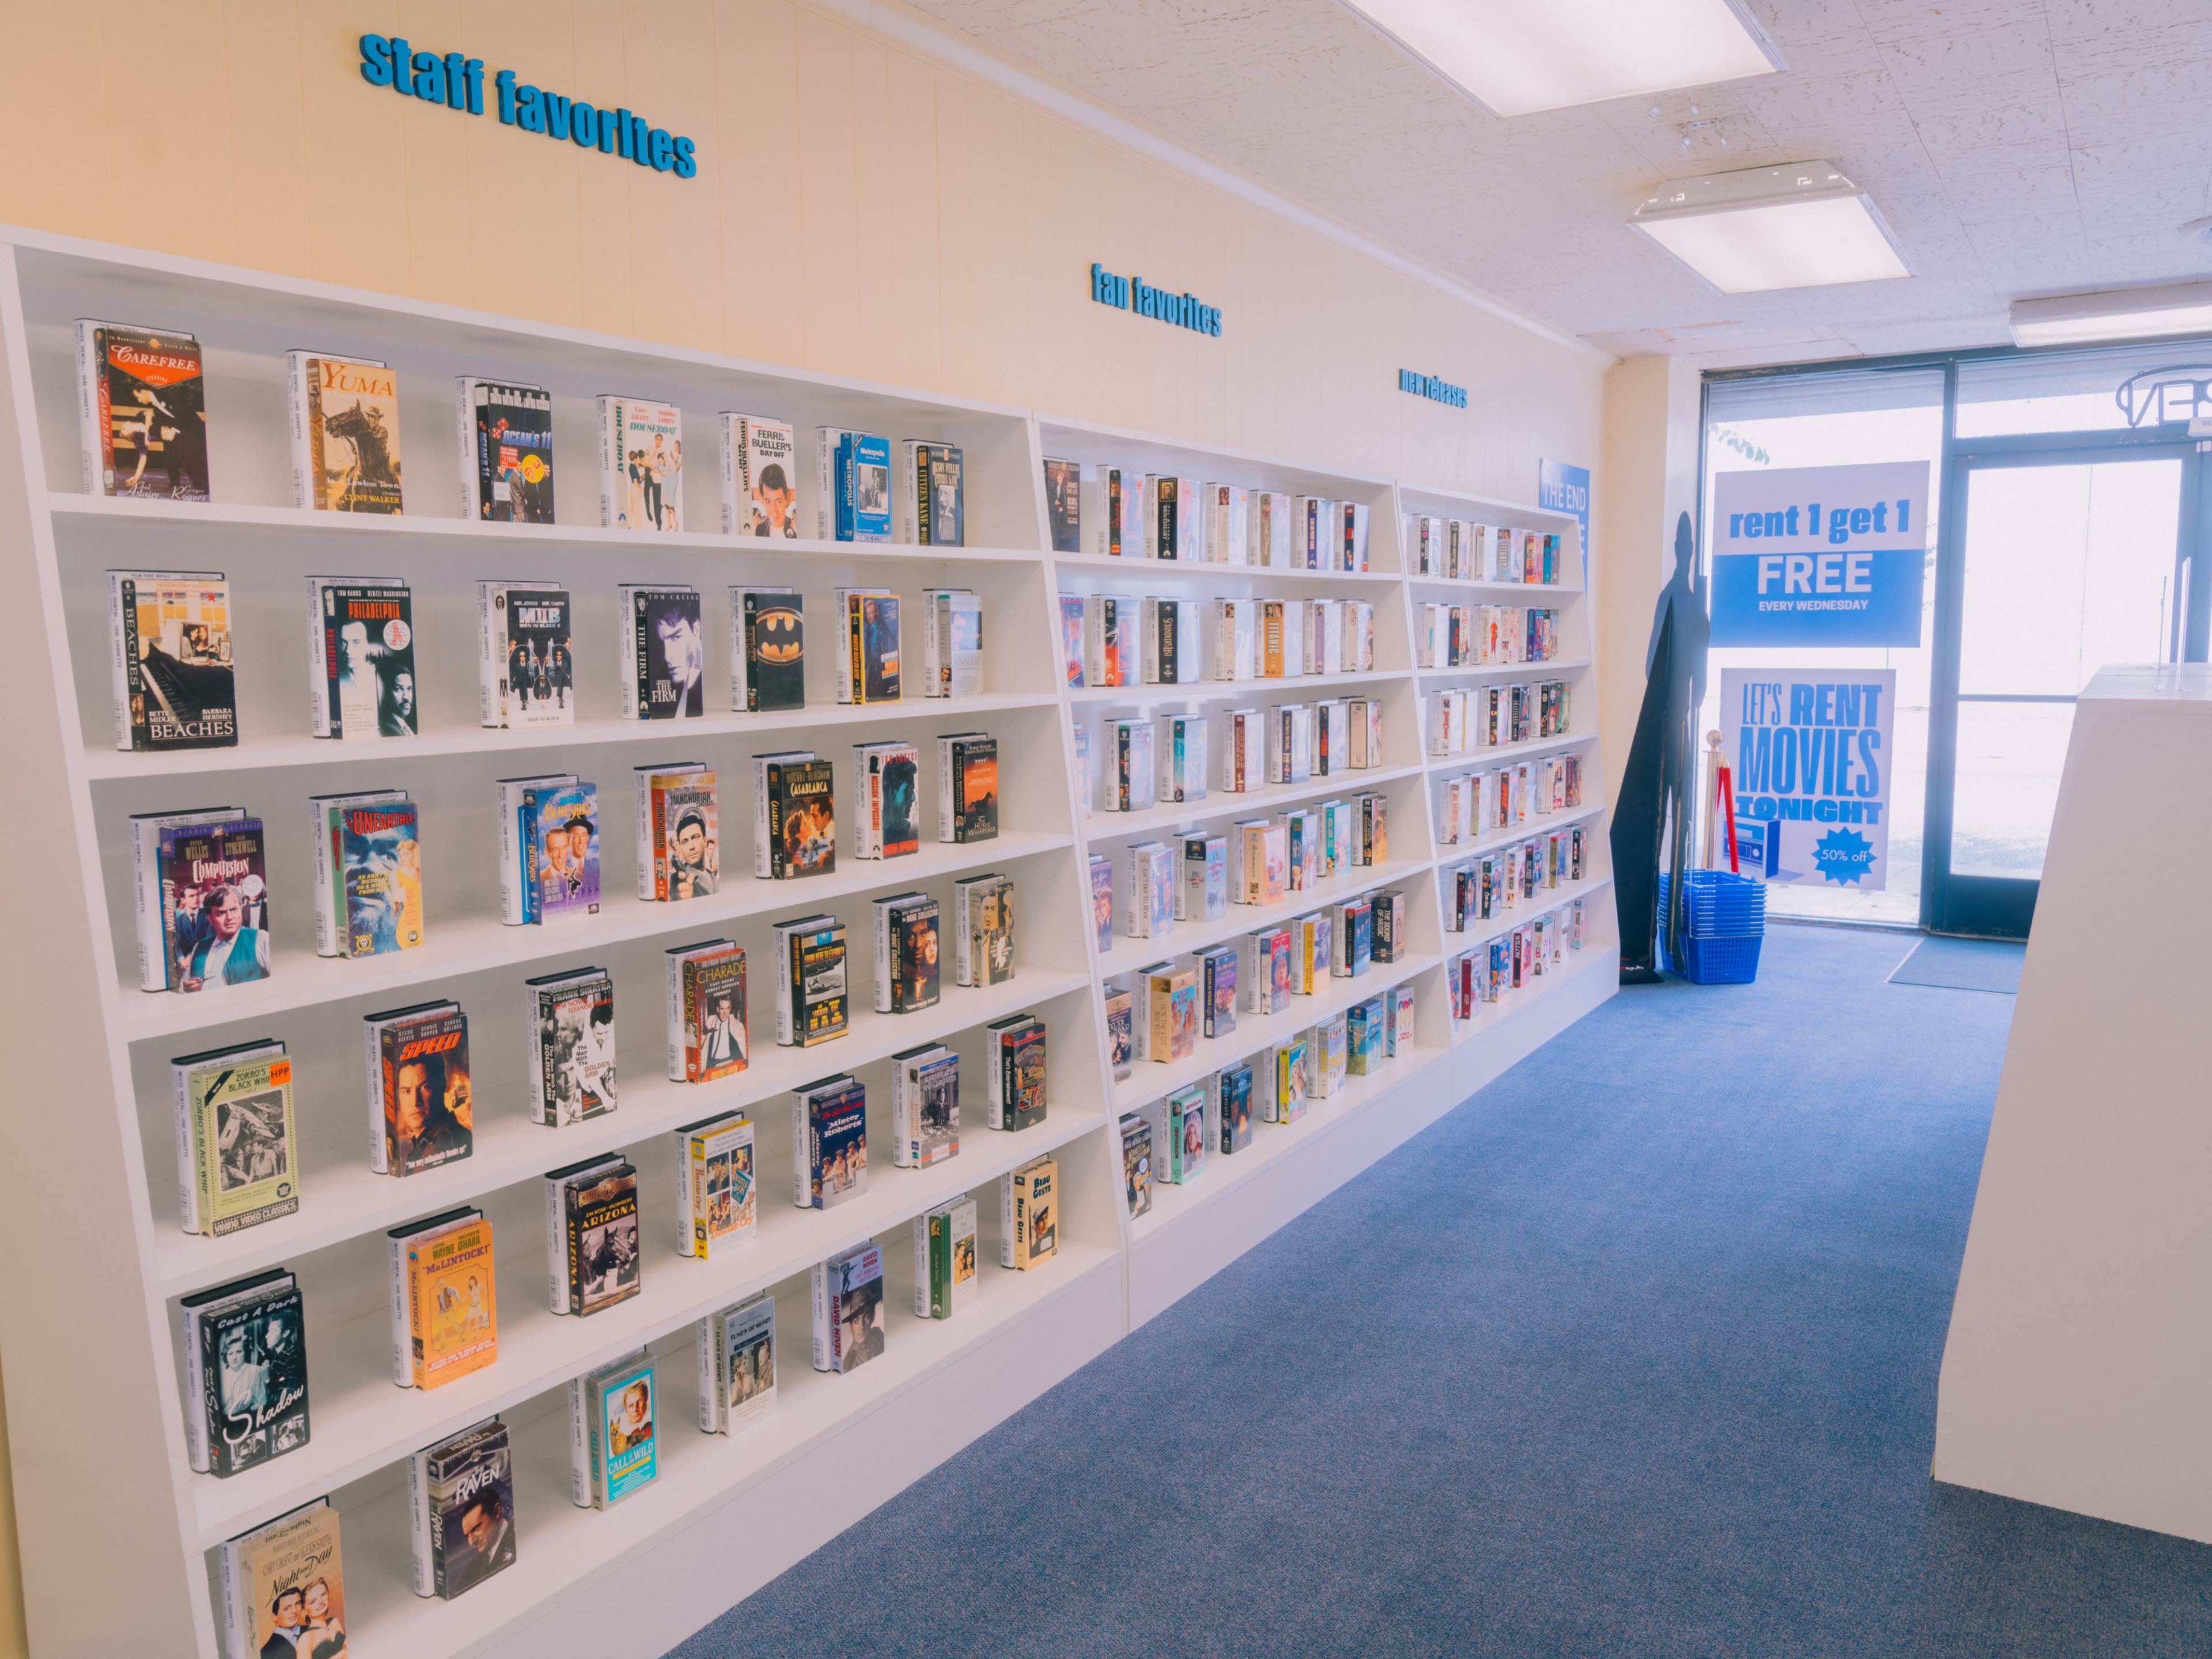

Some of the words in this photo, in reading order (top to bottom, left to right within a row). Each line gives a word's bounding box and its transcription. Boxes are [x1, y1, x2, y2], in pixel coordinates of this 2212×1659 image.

[359, 33, 484, 115] staff
[495, 70, 696, 179] favorites
[1090, 263, 1129, 310] fan
[1131, 276, 1222, 338] favorites
[111, 345, 196, 371] CAREFREE
[321, 362, 392, 396] YUMA
[1399, 369, 1423, 395] new
[1423, 376, 1468, 408] releases
[99, 382, 110, 452] CAREFREE
[630, 422, 677, 434] HOUSEBOAT
[311, 416, 323, 475] YUMA
[502, 430, 540, 448] OCEAN'S
[541, 431, 551, 449] 11
[752, 439, 792, 452] BUELLER'S
[758, 430, 785, 441] FERRIS
[774, 450, 784, 459] OFF
[123, 483, 160, 498] Astaire
[171, 486, 206, 502] Rogers
[369, 495, 399, 503] WALKER
[1543, 481, 1563, 507] THE
[1566, 484, 1586, 512] END
[1730, 505, 1799, 539] rent
[1808, 503, 1821, 535] 1
[1828, 501, 1888, 544] get
[1896, 499, 1910, 532] 1
[1758, 553, 1873, 594] FREE
[349, 602, 400, 619] PHILADELPHIA
[1759, 601, 1794, 611] EVERY
[1796, 600, 1869, 611] WEDNESDAY
[126, 608, 138, 685] BEACHES
[1268, 622, 1280, 654] TITANIC
[325, 628, 338, 679] PHILADELPHIA
[639, 651, 647, 680] FIRM
[652, 690, 677, 702] FIRM
[656, 682, 671, 691] THE
[1743, 683, 1782, 725] LET'S
[1790, 684, 1883, 727] RENT
[151, 722, 234, 739] BEACHES
[1738, 726, 1881, 798] MOVIES
[671, 792, 711, 805] MANCHURIAN
[790, 782, 828, 796] CASABLANCA
[771, 801, 779, 835] CASABLANCA
[1735, 796, 1883, 824] TONIGHT
[353, 811, 415, 836] UNEARTHLY
[1821, 850, 1848, 861] 50%
[1851, 851, 1868, 862] off
[192, 857, 249, 883] COMPULSION
[697, 960, 746, 984] CHARADE
[553, 989, 579, 1002] FRANK
[579, 983, 612, 997] SINATRA
[684, 964, 695, 1022] CHARADE
[400, 1032, 461, 1060] SPEED
[236, 1069, 266, 1082] ZORRO'S
[271, 1067, 290, 1079] HPP
[584, 1060, 610, 1073] GOLDEN
[585, 1070, 599, 1079] ARM
[228, 1080, 252, 1092] BLACK
[383, 1056, 396, 1124] SPEED
[195, 1096, 204, 1137] ZORRO'S
[1033, 1185, 1051, 1199] GESTE
[1034, 1176, 1050, 1189] BEAU
[581, 1203, 636, 1229] ARIZONA
[433, 1244, 454, 1260] WAYNE
[569, 1219, 577, 1286] ARIZONA
[863, 1251, 878, 1263] DAVID
[218, 1313, 248, 1329] Cast
[253, 1307, 262, 1317] A
[267, 1296, 298, 1312] Dark
[832, 1296, 840, 1326] DAVID
[222, 1384, 304, 1444] Shadow
[475, 1465, 485, 1474] THE
[608, 1459, 628, 1475] CALL
[634, 1442, 654, 1460] WILD
[456, 1465, 499, 1505] RAVEN
[431, 1511, 442, 1550] RAVEN
[305, 1546, 332, 1578] Day
